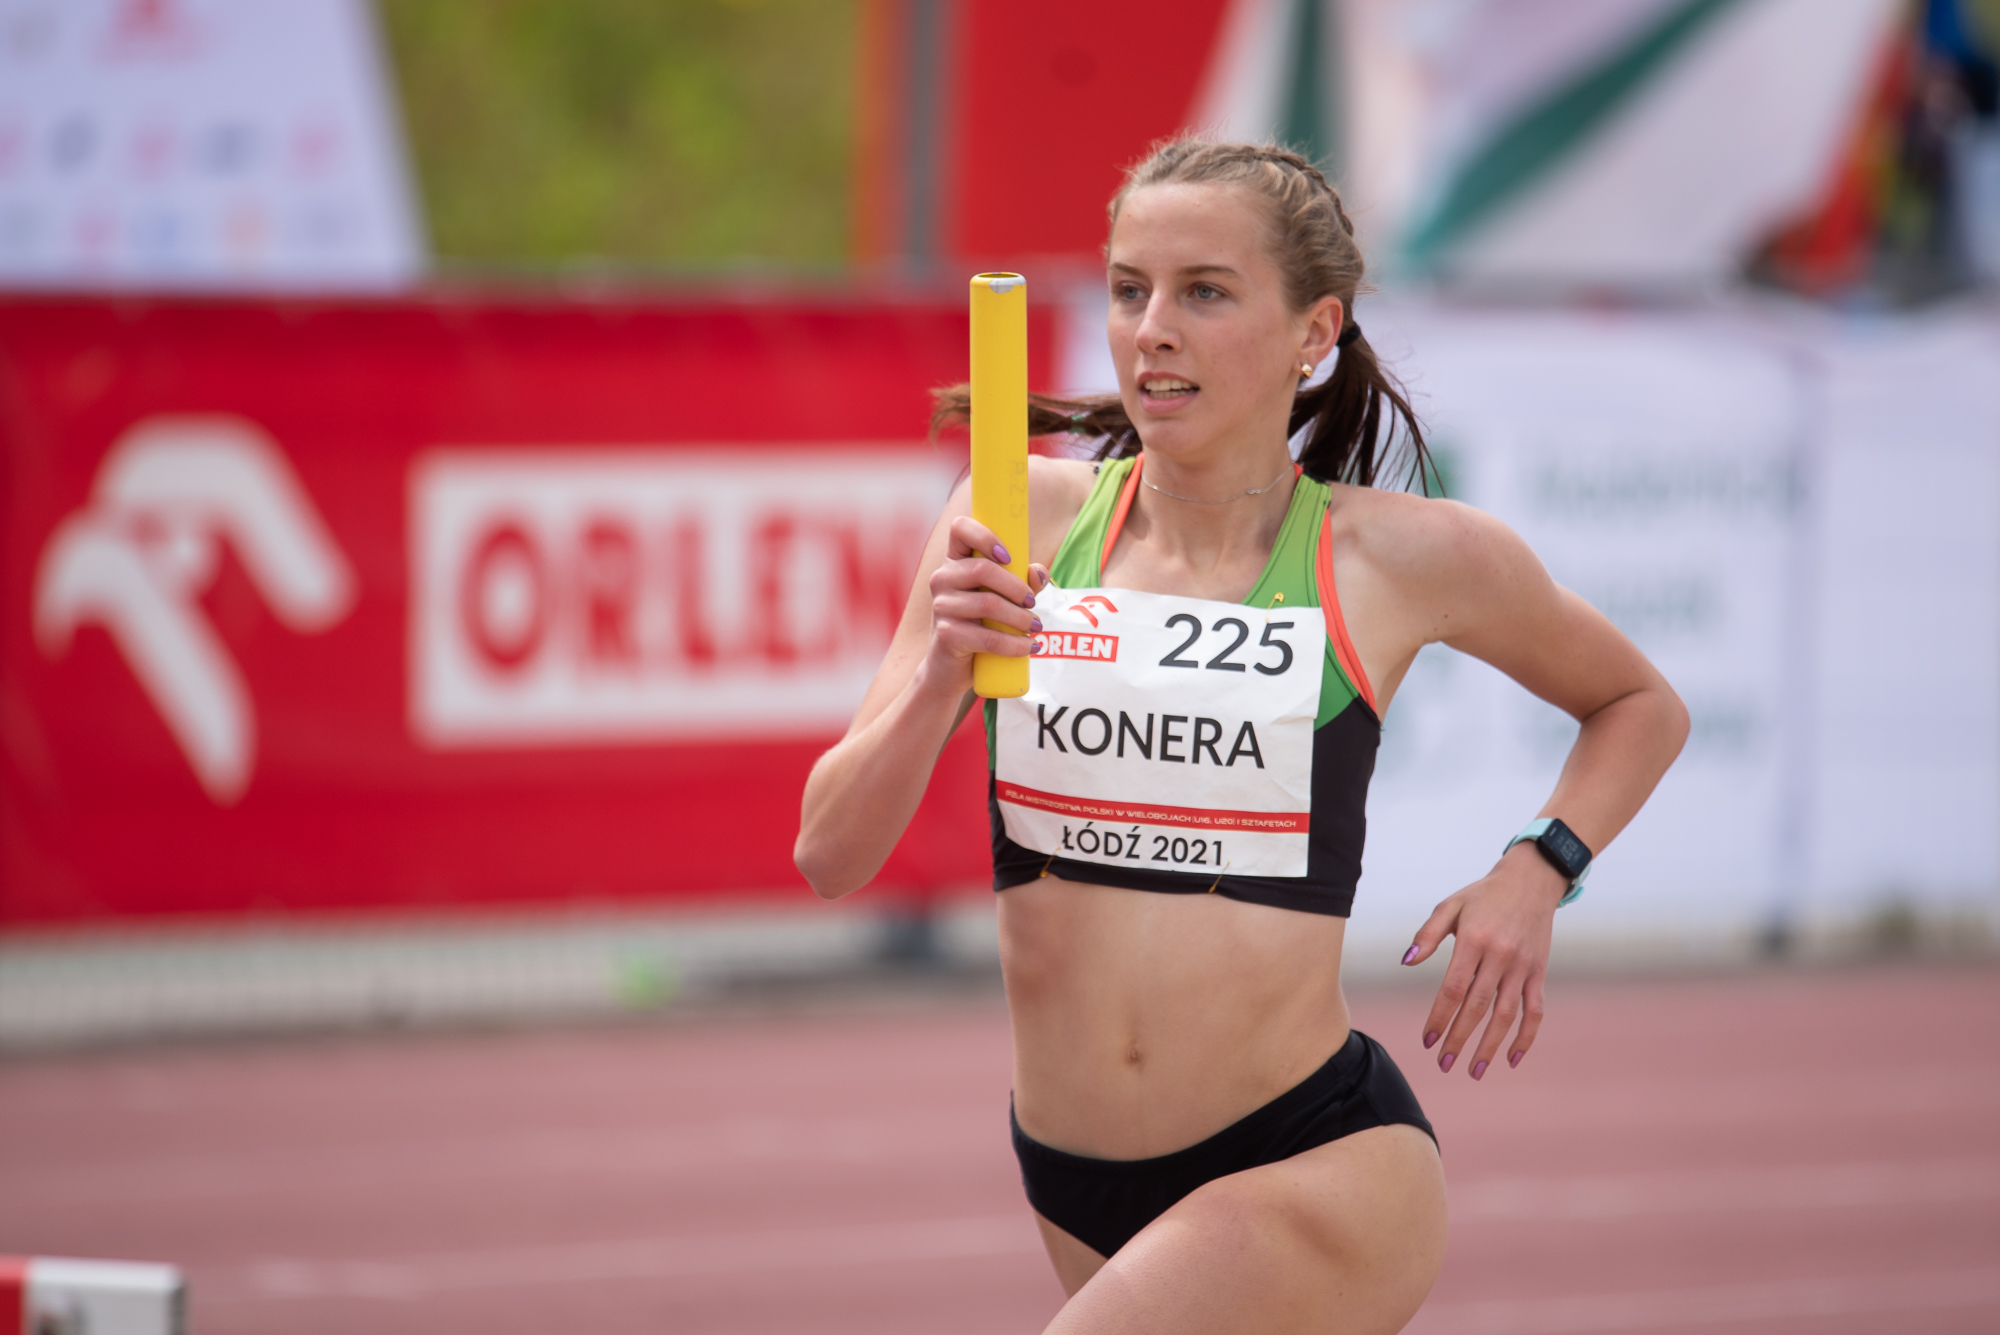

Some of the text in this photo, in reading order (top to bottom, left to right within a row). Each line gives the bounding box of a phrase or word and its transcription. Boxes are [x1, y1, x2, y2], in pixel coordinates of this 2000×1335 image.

[461, 513, 928, 680] ORLEN
[1033, 634, 1113, 659] ORLEN
[1159, 613, 1294, 676] 225
[1037, 704, 1265, 769] KONERA
[1025, 795, 1082, 813] MISTRZOSTWA
[1082, 806, 1114, 816] POLSKI
[1115, 809, 1125, 817] W
[1126, 810, 1191, 823] WIELOBOJACH
[1241, 818, 1297, 828] SZTAFETACH
[1062, 821, 1222, 866] ŁÓDŹ 2021
